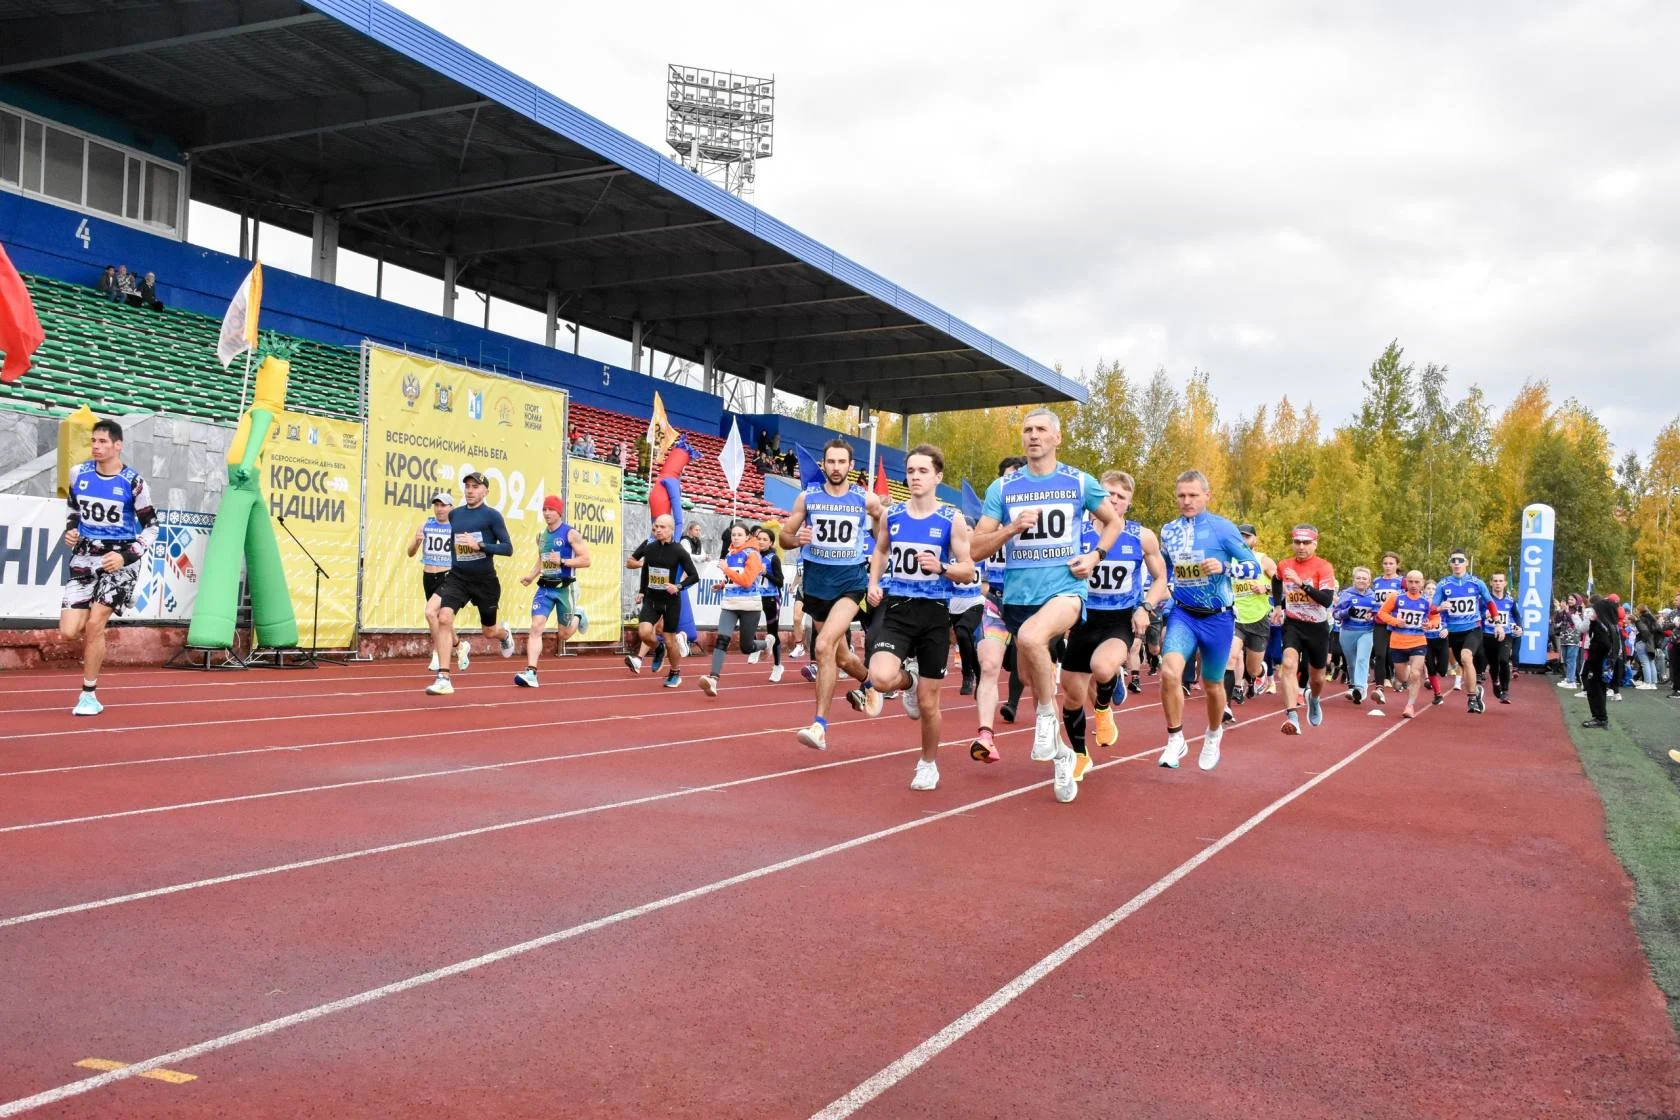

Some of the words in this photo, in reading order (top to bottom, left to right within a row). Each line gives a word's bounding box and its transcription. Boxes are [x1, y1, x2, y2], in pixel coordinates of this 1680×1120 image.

[75, 218, 91, 249] 4
[602, 365, 610, 386] 5
[386, 430, 466, 452] ВСЕРОССИЙСКИЙ
[467, 445, 489, 457] ДЕНЬ
[490, 448, 508, 461] БЕГА
[270, 464, 329, 494] КРОСС
[385, 452, 438, 482] КРОСС
[270, 493, 345, 523] НАЦИИ
[1005, 489, 1077, 504] НИЖНЕВАРТОВСК
[79, 499, 121, 523] 306
[574, 502, 605, 522] КРОСС
[816, 519, 853, 543] 310
[427, 536, 451, 552] 106
[1012, 549, 1040, 561] ГОРОД
[1042, 546, 1074, 558] СПОРТА
[1089, 565, 1128, 590] 319
[1175, 564, 1200, 578] 9016
[1450, 599, 1475, 613] 302
[1522, 545, 1543, 651] СТАРТ
